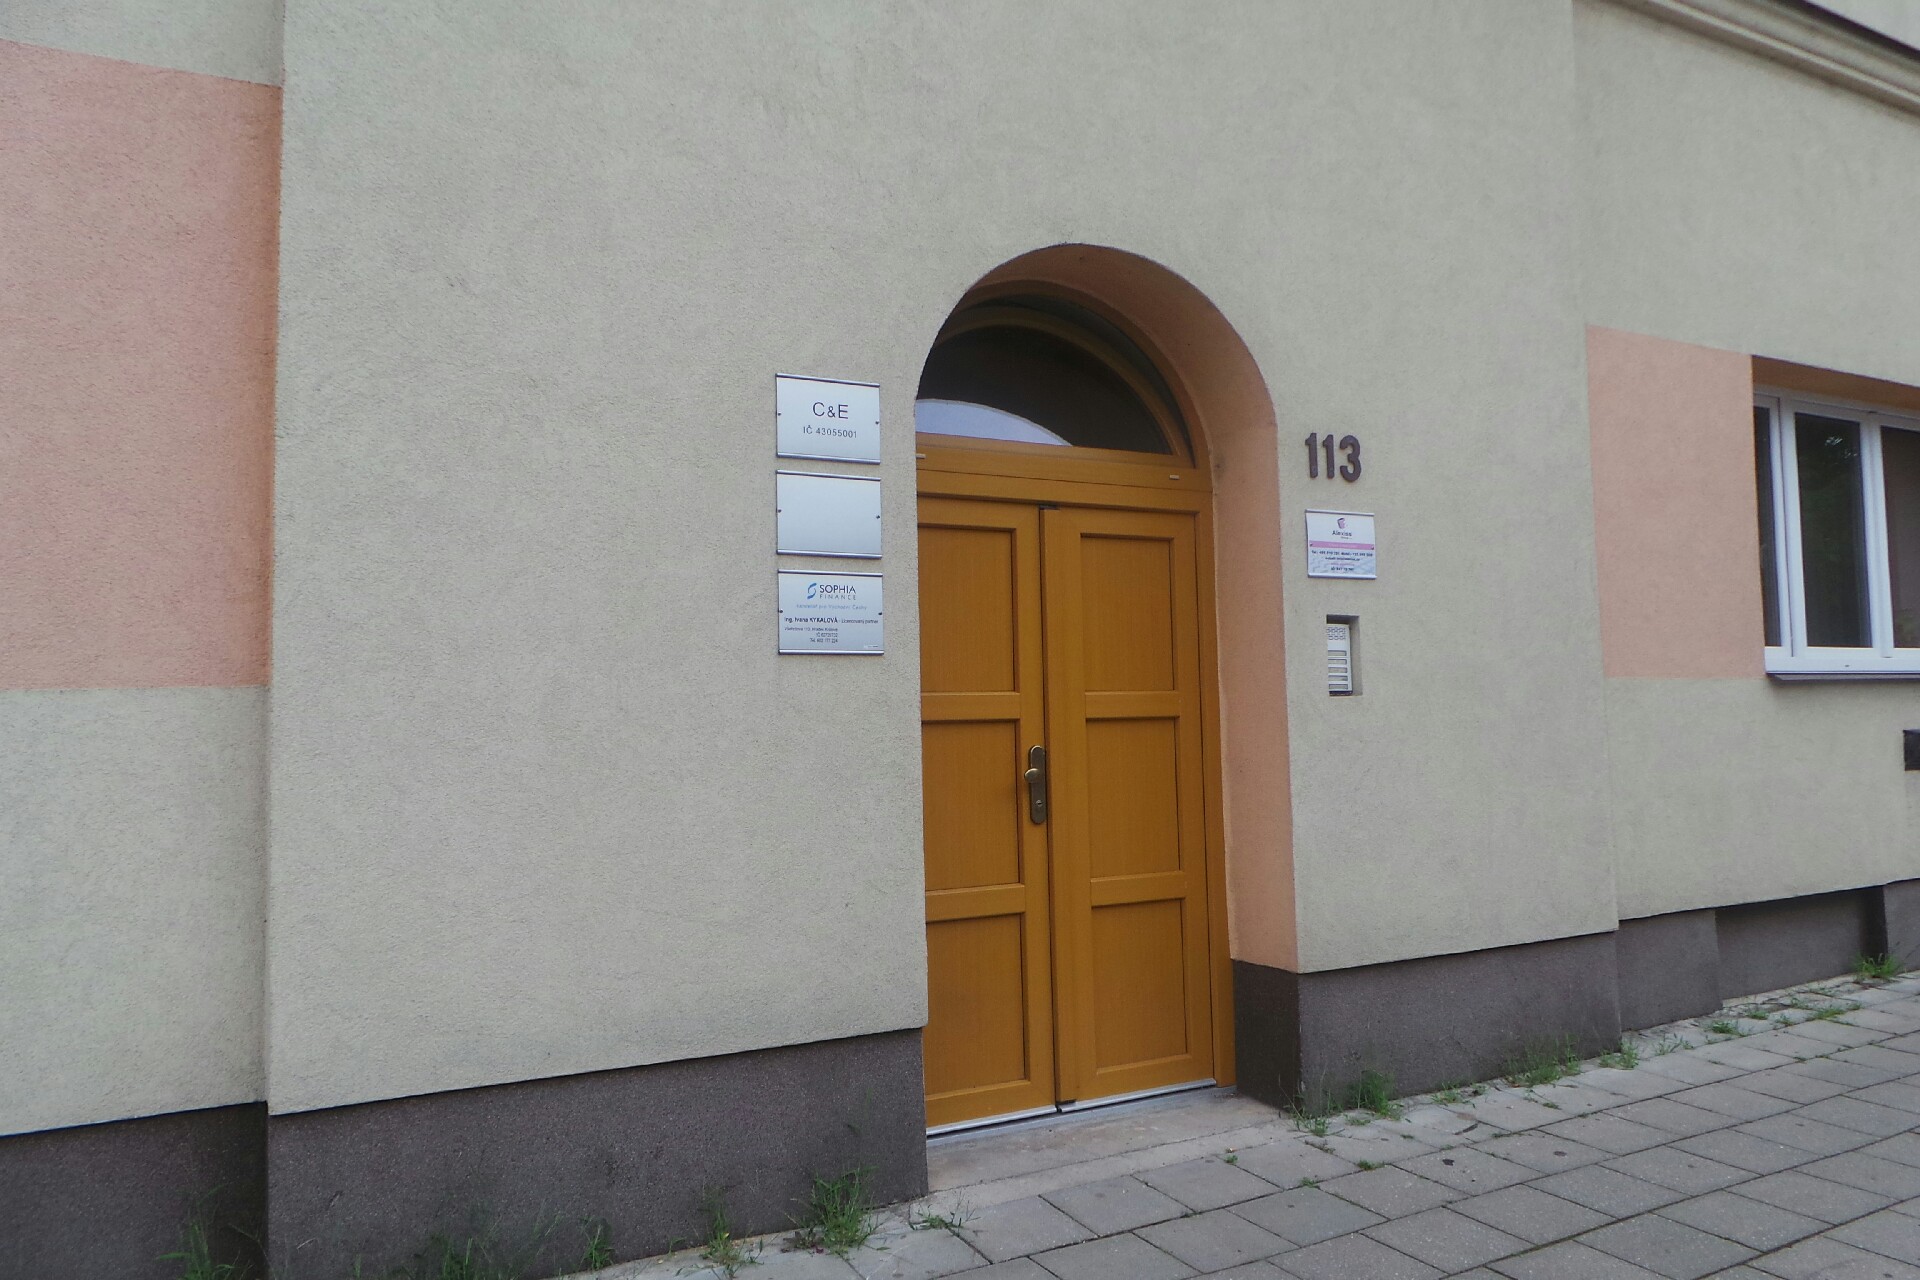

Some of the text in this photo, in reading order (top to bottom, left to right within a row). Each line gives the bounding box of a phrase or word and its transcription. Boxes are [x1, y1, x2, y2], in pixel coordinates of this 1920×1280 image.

[803, 425, 857, 438] IČ 43055001
[1305, 432, 1362, 483] 113
[820, 585, 856, 594] SOPHIA
